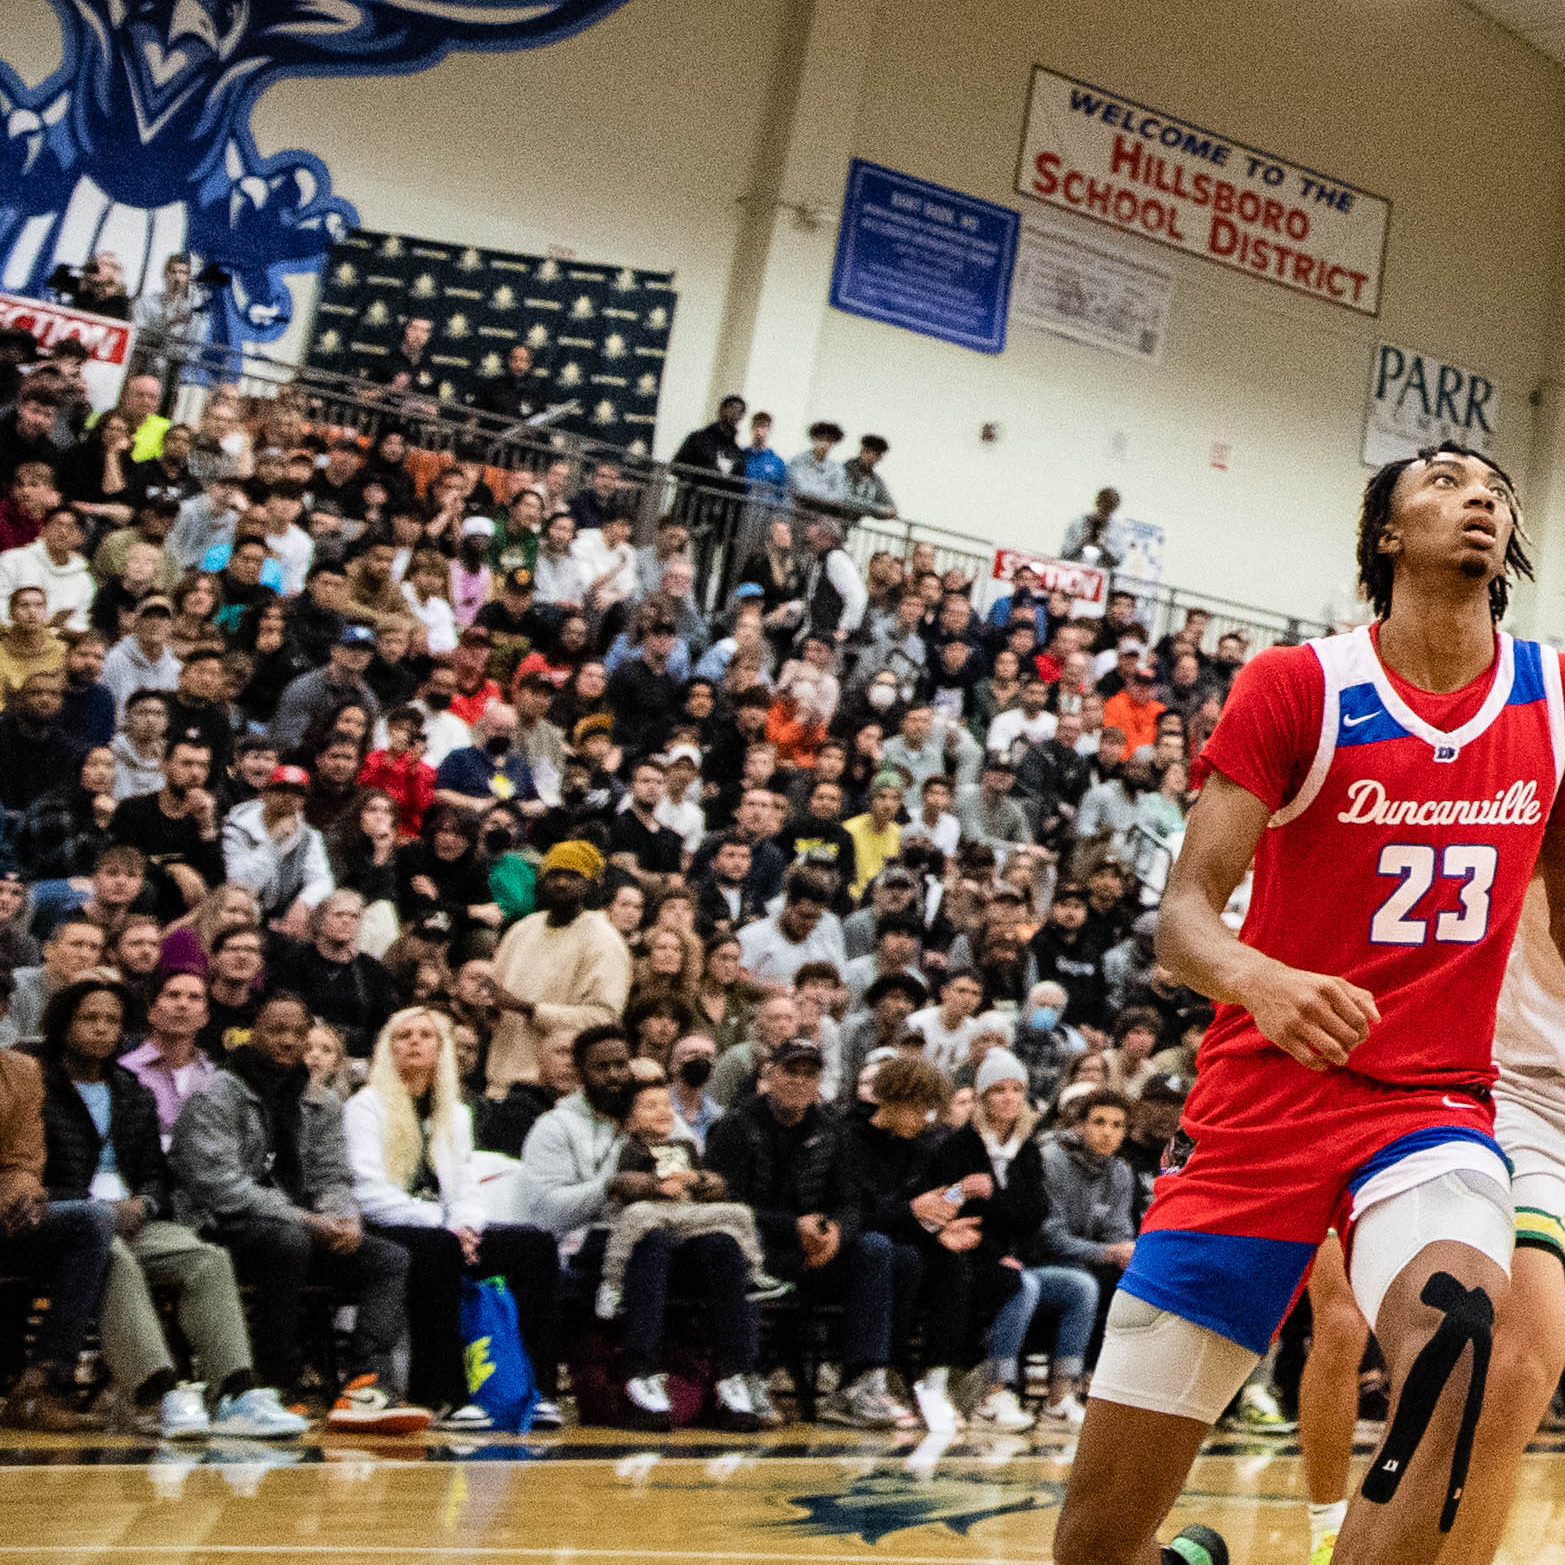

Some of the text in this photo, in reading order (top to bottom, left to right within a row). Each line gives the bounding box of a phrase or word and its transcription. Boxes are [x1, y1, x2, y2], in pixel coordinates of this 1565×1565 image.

[1069, 88, 1357, 214] WELCOME TO THE
[1110, 135, 1311, 242] HILLSBORO
[1032, 151, 1184, 241] SCHOOL
[1207, 214, 1369, 301] DISTRICT
[1375, 345, 1494, 434] PARR
[1337, 778, 1542, 826] Duncanville
[1369, 842, 1499, 947] 23
